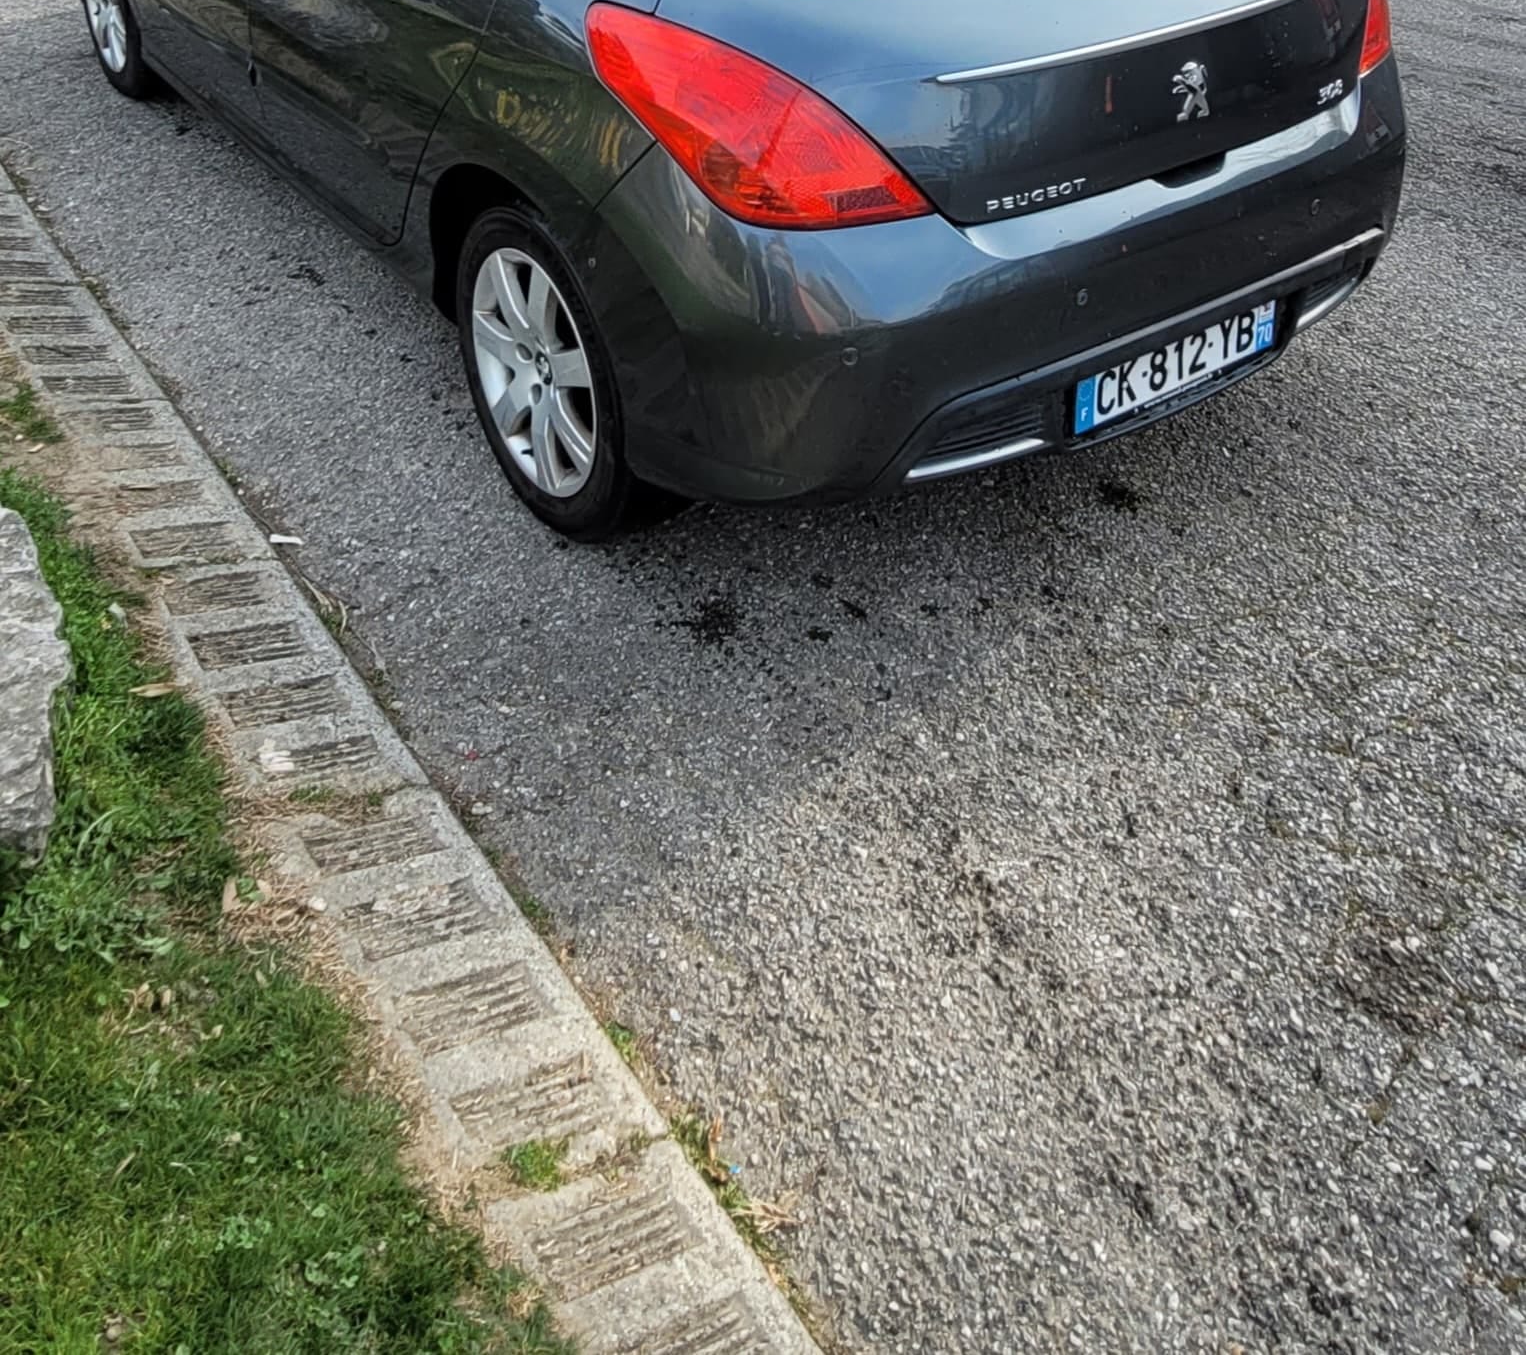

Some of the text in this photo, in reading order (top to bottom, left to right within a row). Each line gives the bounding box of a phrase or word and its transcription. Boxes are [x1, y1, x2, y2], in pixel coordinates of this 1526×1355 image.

[986, 177, 1087, 214] PEUGEOT
[1081, 407, 1089, 422] F
[1258, 322, 1273, 346] 70
